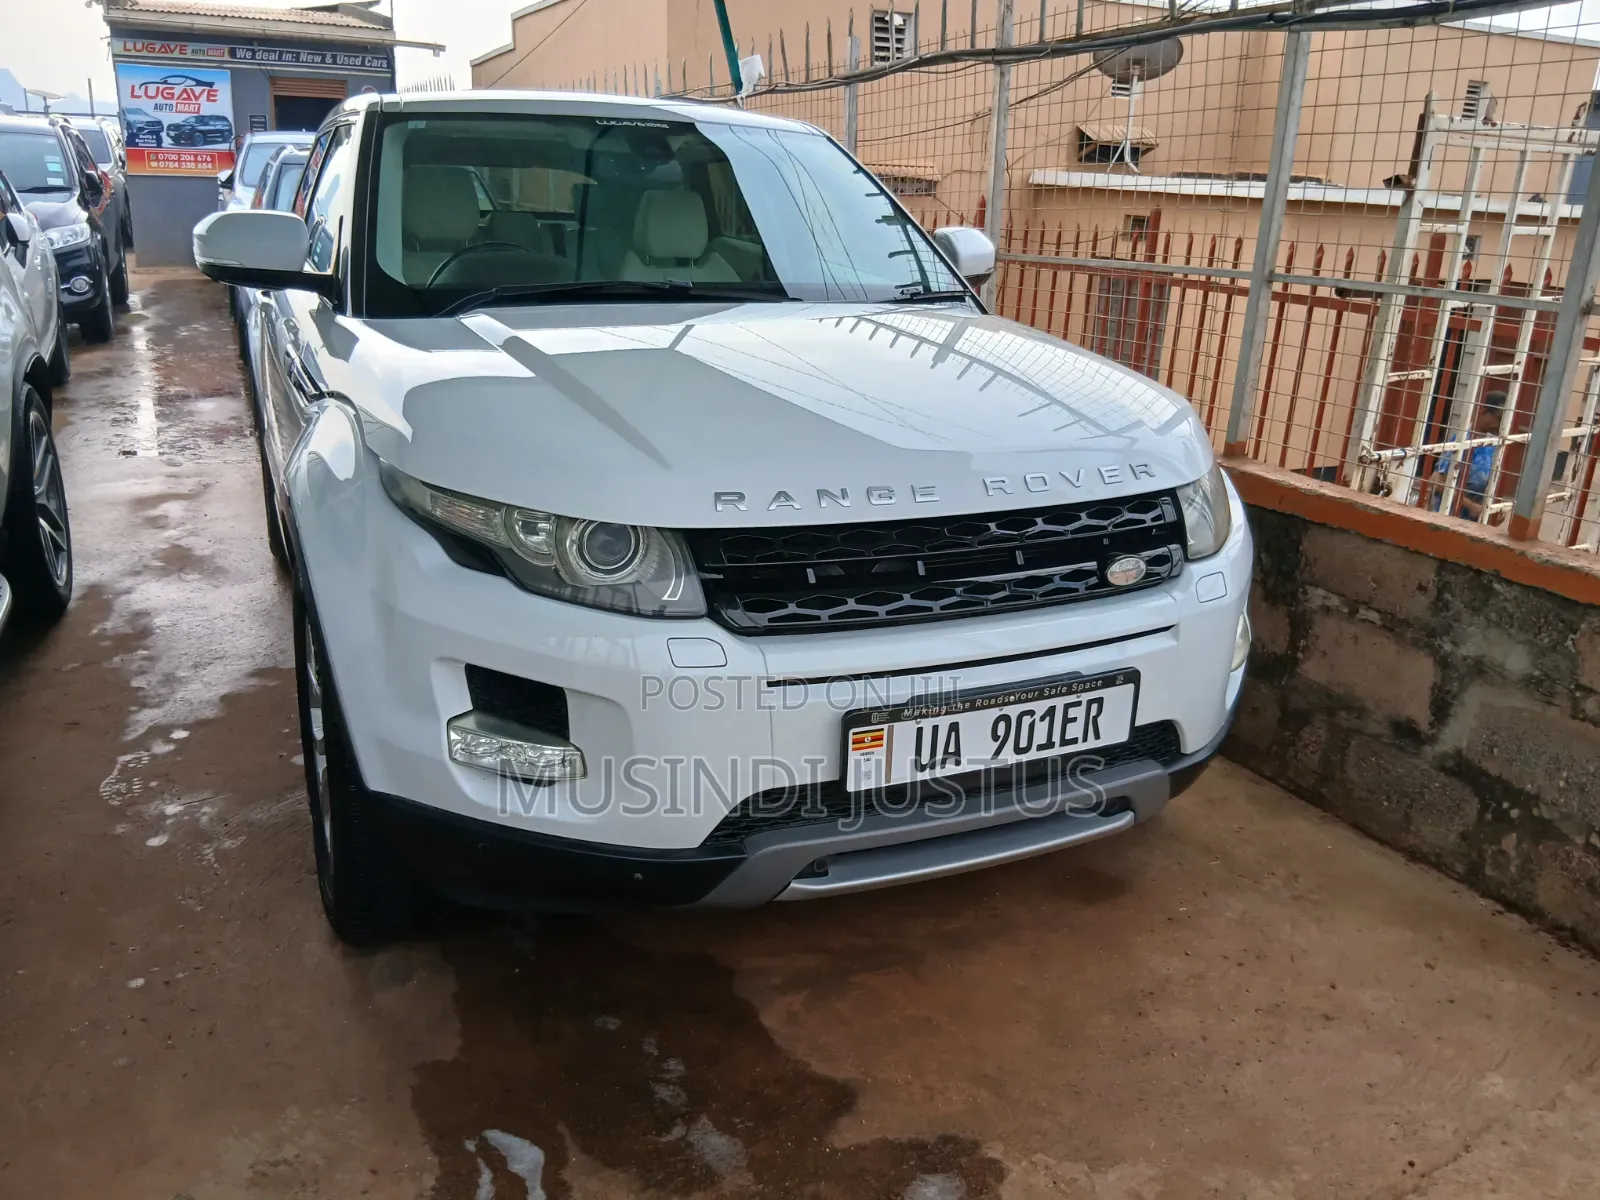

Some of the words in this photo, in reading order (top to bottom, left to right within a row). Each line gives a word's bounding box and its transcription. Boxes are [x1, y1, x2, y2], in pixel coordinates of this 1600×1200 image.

[123, 40, 188, 55] LUGAVE
[191, 48, 206, 56] AUTO
[207, 48, 225, 57] MART
[236, 48, 252, 59] We
[255, 49, 279, 60] deal
[282, 51, 296, 61] in:
[300, 53, 322, 63] New
[325, 54, 333, 64] &
[337, 54, 362, 66] Used
[365, 56, 388, 68] Cars
[130, 84, 219, 102] LUGAVE
[153, 103, 174, 112] AUTO
[176, 103, 199, 113] MART
[714, 483, 940, 512] RANGE
[982, 463, 1157, 497] ROVER
[903, 704, 947, 717] Making
[952, 702, 971, 711] the
[1014, 690, 1039, 701] Your
[1044, 685, 1067, 696] Safe
[1071, 679, 1103, 692] Space
[914, 721, 962, 773] UA
[990, 696, 1104, 761] 901ER
